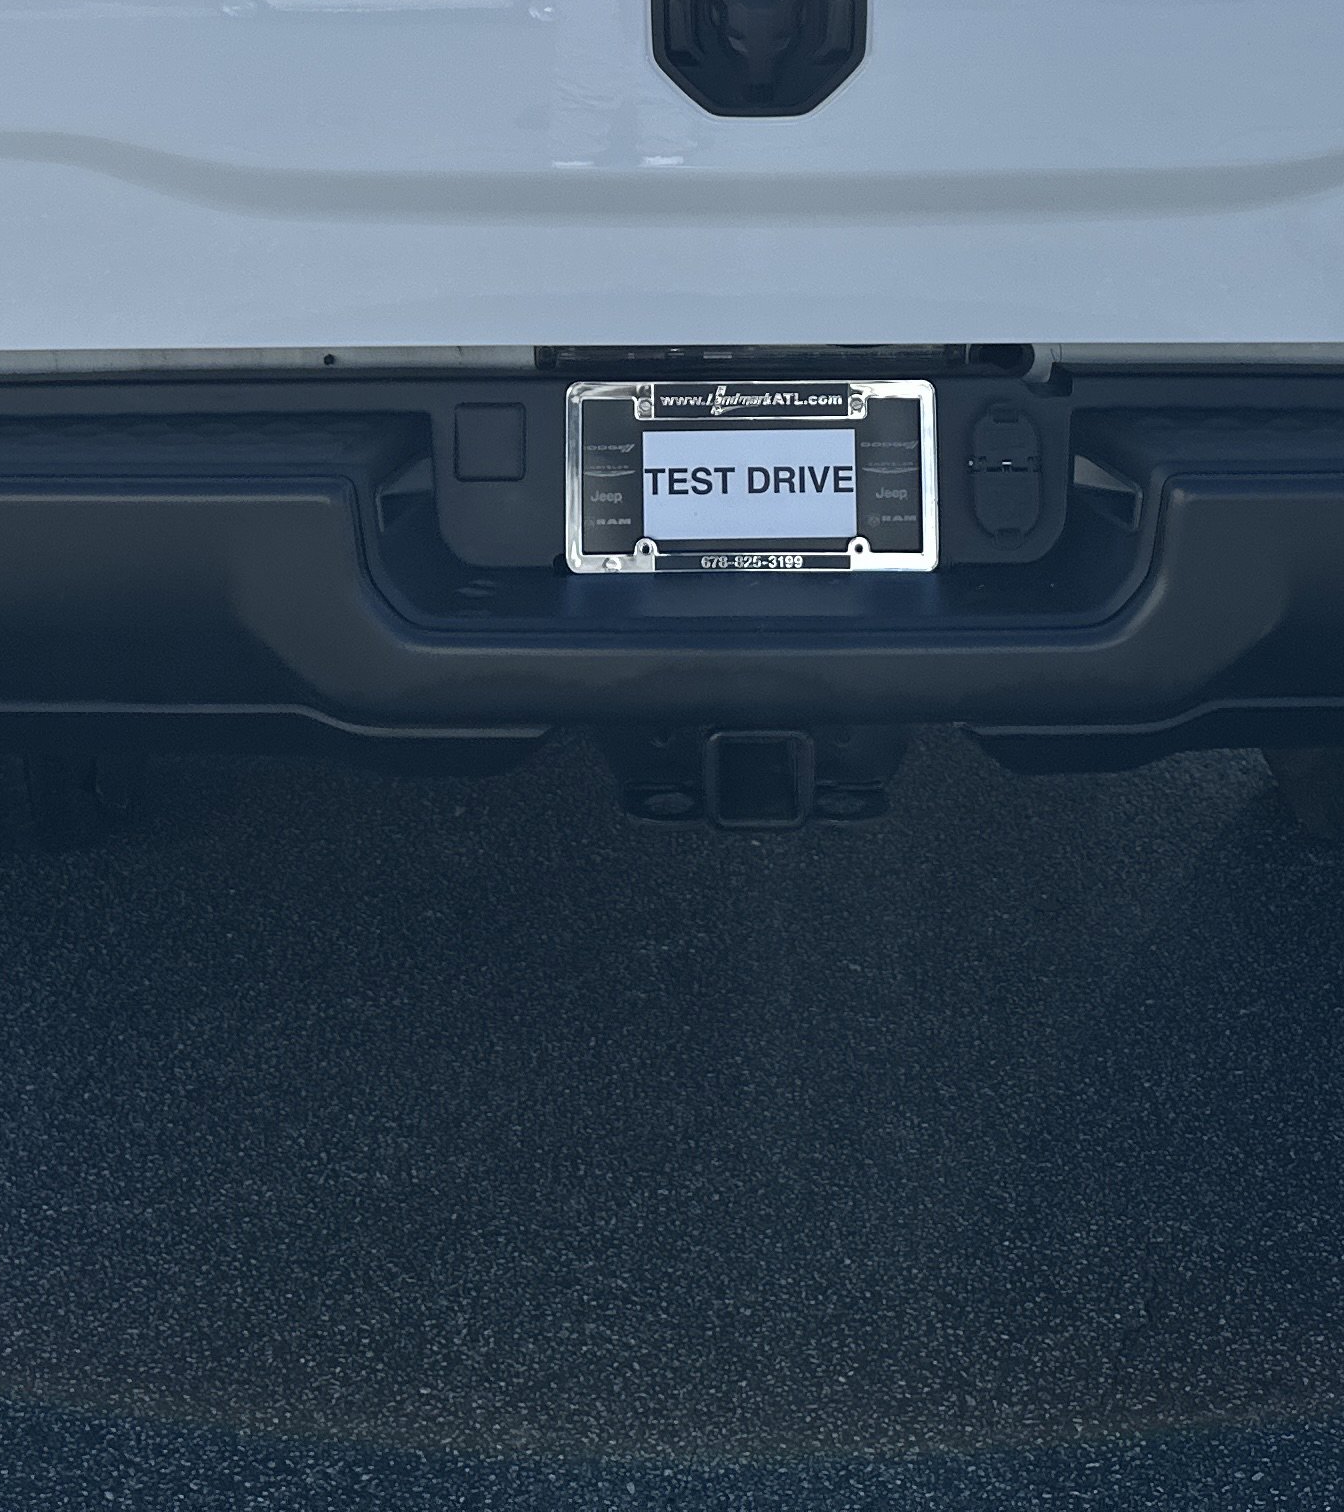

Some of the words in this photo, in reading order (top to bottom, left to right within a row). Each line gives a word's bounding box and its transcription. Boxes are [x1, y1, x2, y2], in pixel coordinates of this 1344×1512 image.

[644, 467, 736, 496] TEST
[746, 465, 855, 494] DRIVE
[590, 489, 623, 504] Jeep
[875, 486, 908, 501] Jeep
[701, 555, 803, 569] 678-825-3199
